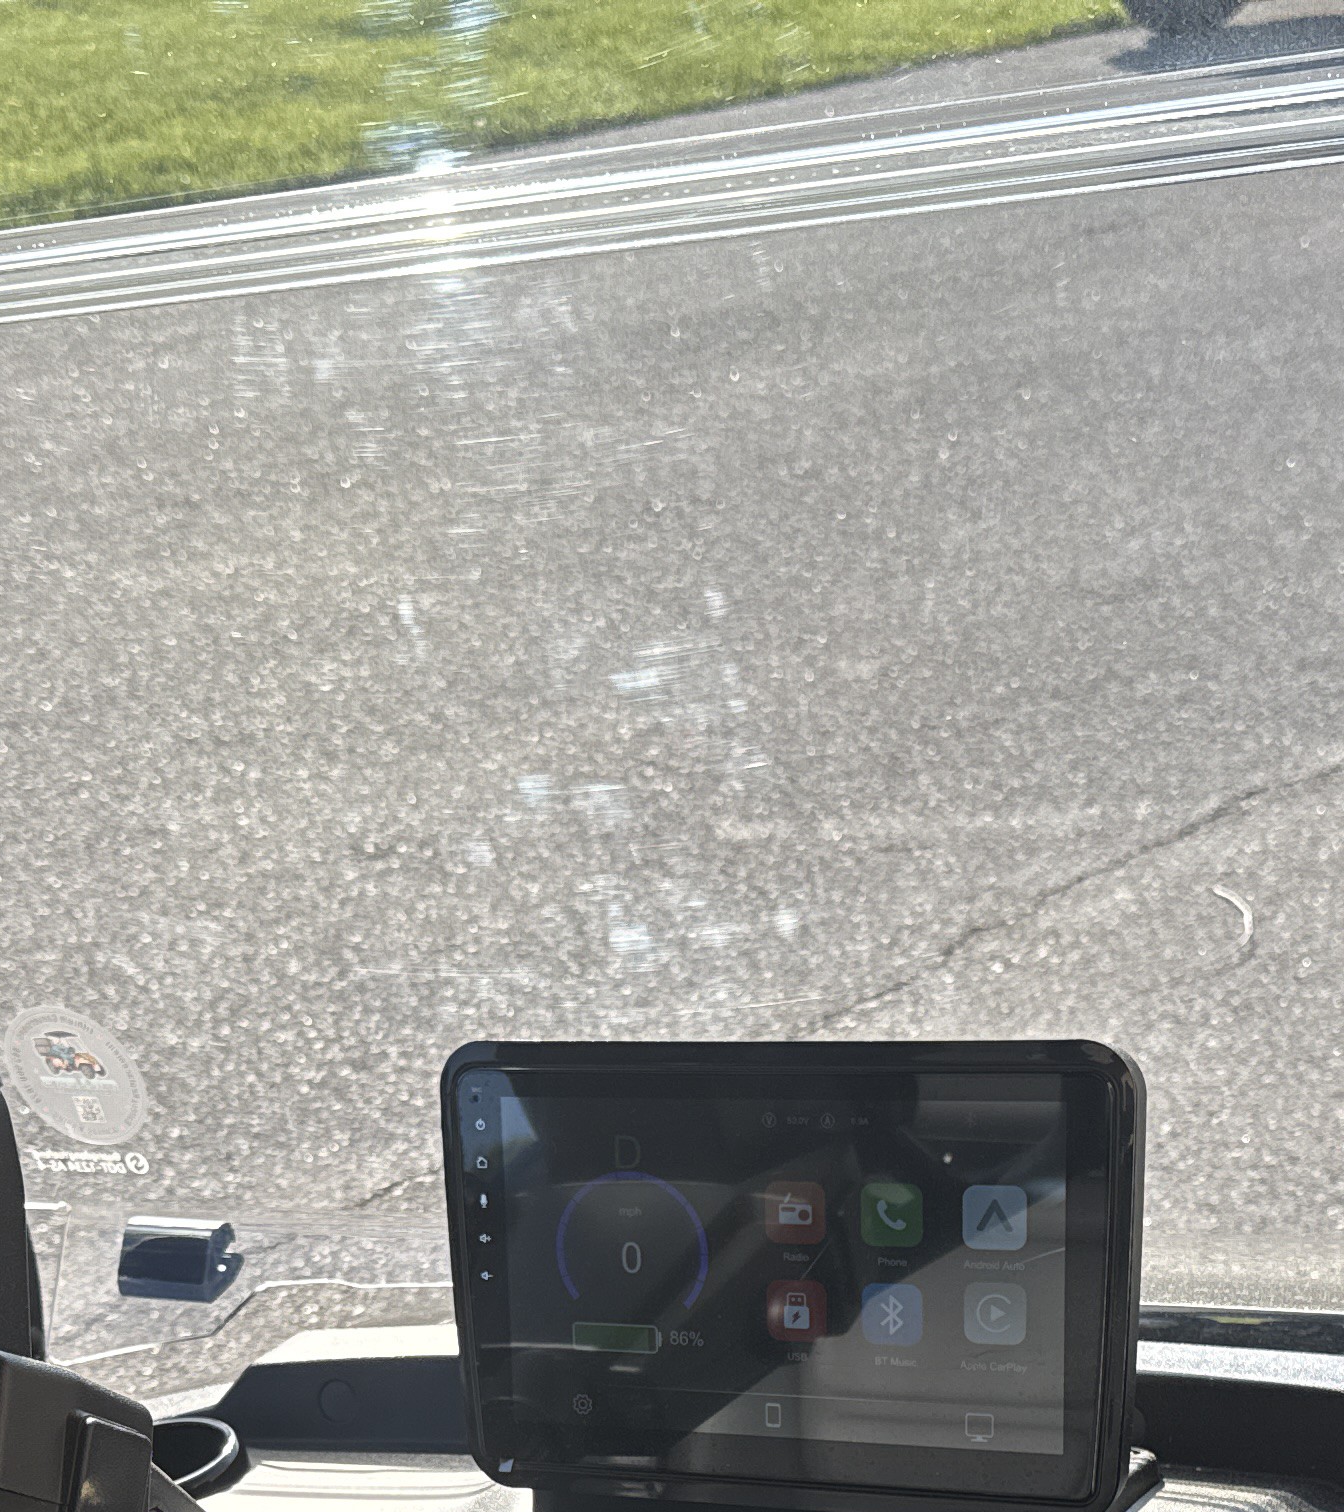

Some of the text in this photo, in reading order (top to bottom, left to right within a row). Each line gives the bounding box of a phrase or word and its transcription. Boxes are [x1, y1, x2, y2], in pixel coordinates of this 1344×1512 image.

[613, 1134, 641, 1169] D
[618, 1206, 642, 1218] mph
[620, 1240, 643, 1274] 0
[782, 1251, 810, 1263] Radio
[877, 1256, 908, 1268] Phone
[963, 1259, 1026, 1272] Android Auto
[669, 1330, 705, 1348] 86%
[787, 1351, 808, 1362] USB
[874, 1356, 917, 1368] BT Music
[960, 1360, 1028, 1374] Apple CarPlay
